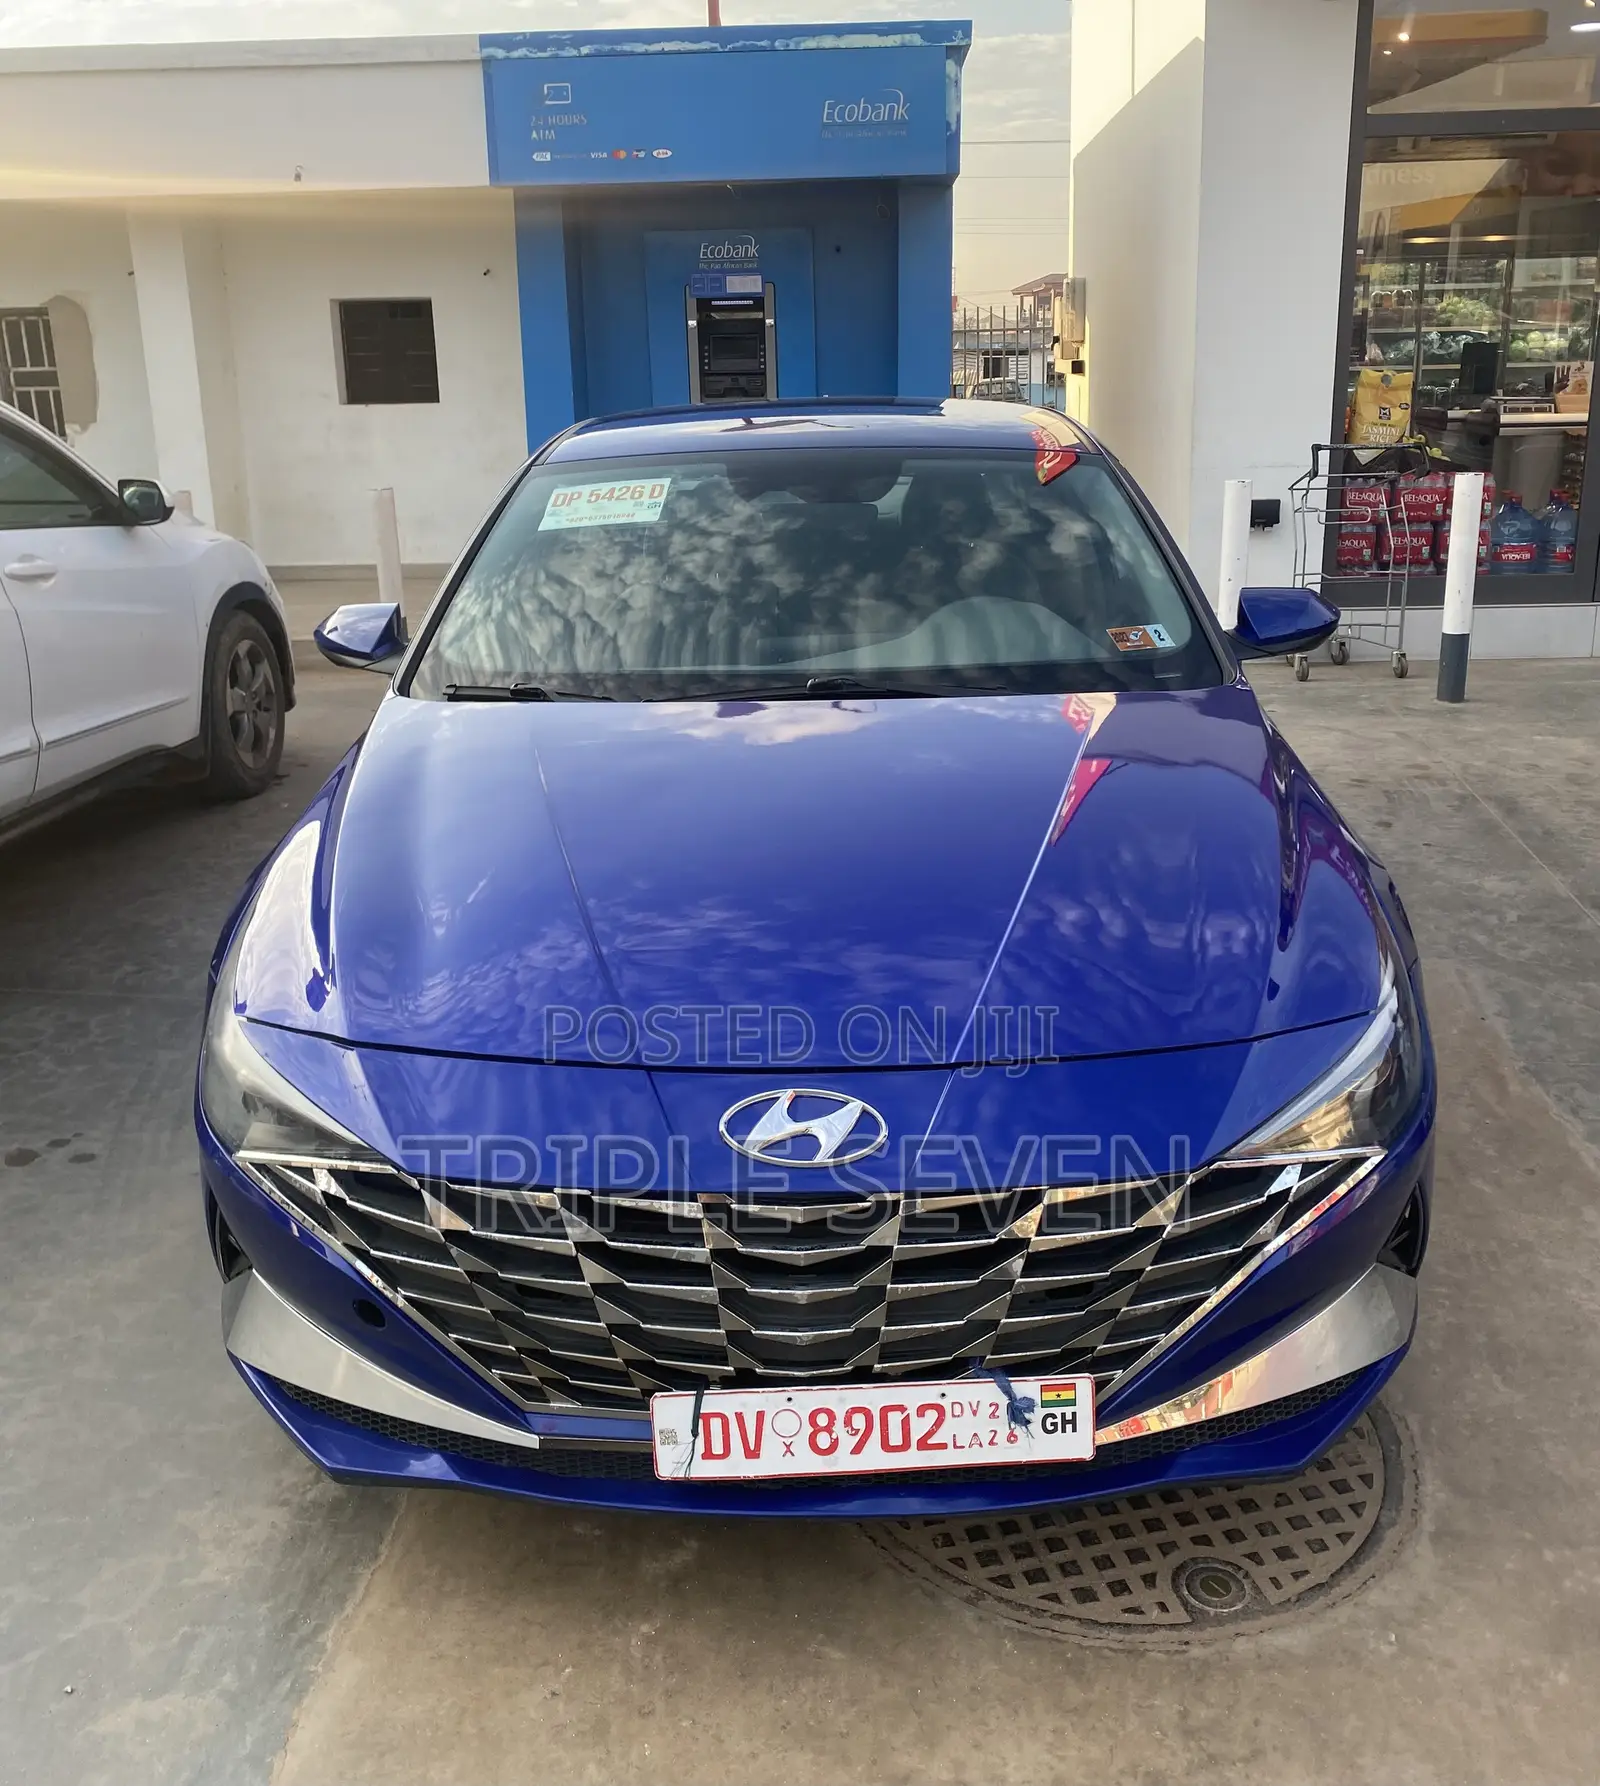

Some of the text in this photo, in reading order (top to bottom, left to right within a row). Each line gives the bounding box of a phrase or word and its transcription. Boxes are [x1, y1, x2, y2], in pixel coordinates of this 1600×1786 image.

[822, 88, 911, 123] Ecobank
[547, 113, 588, 126] HOURS
[531, 129, 556, 141] ATM
[590, 151, 608, 160] VISA
[699, 234, 760, 259] Ecobank
[552, 484, 665, 507] DP 5426 D
[700, 1410, 766, 1461] DV
[807, 1402, 949, 1457] 8902
[1041, 1411, 1078, 1435] GH
